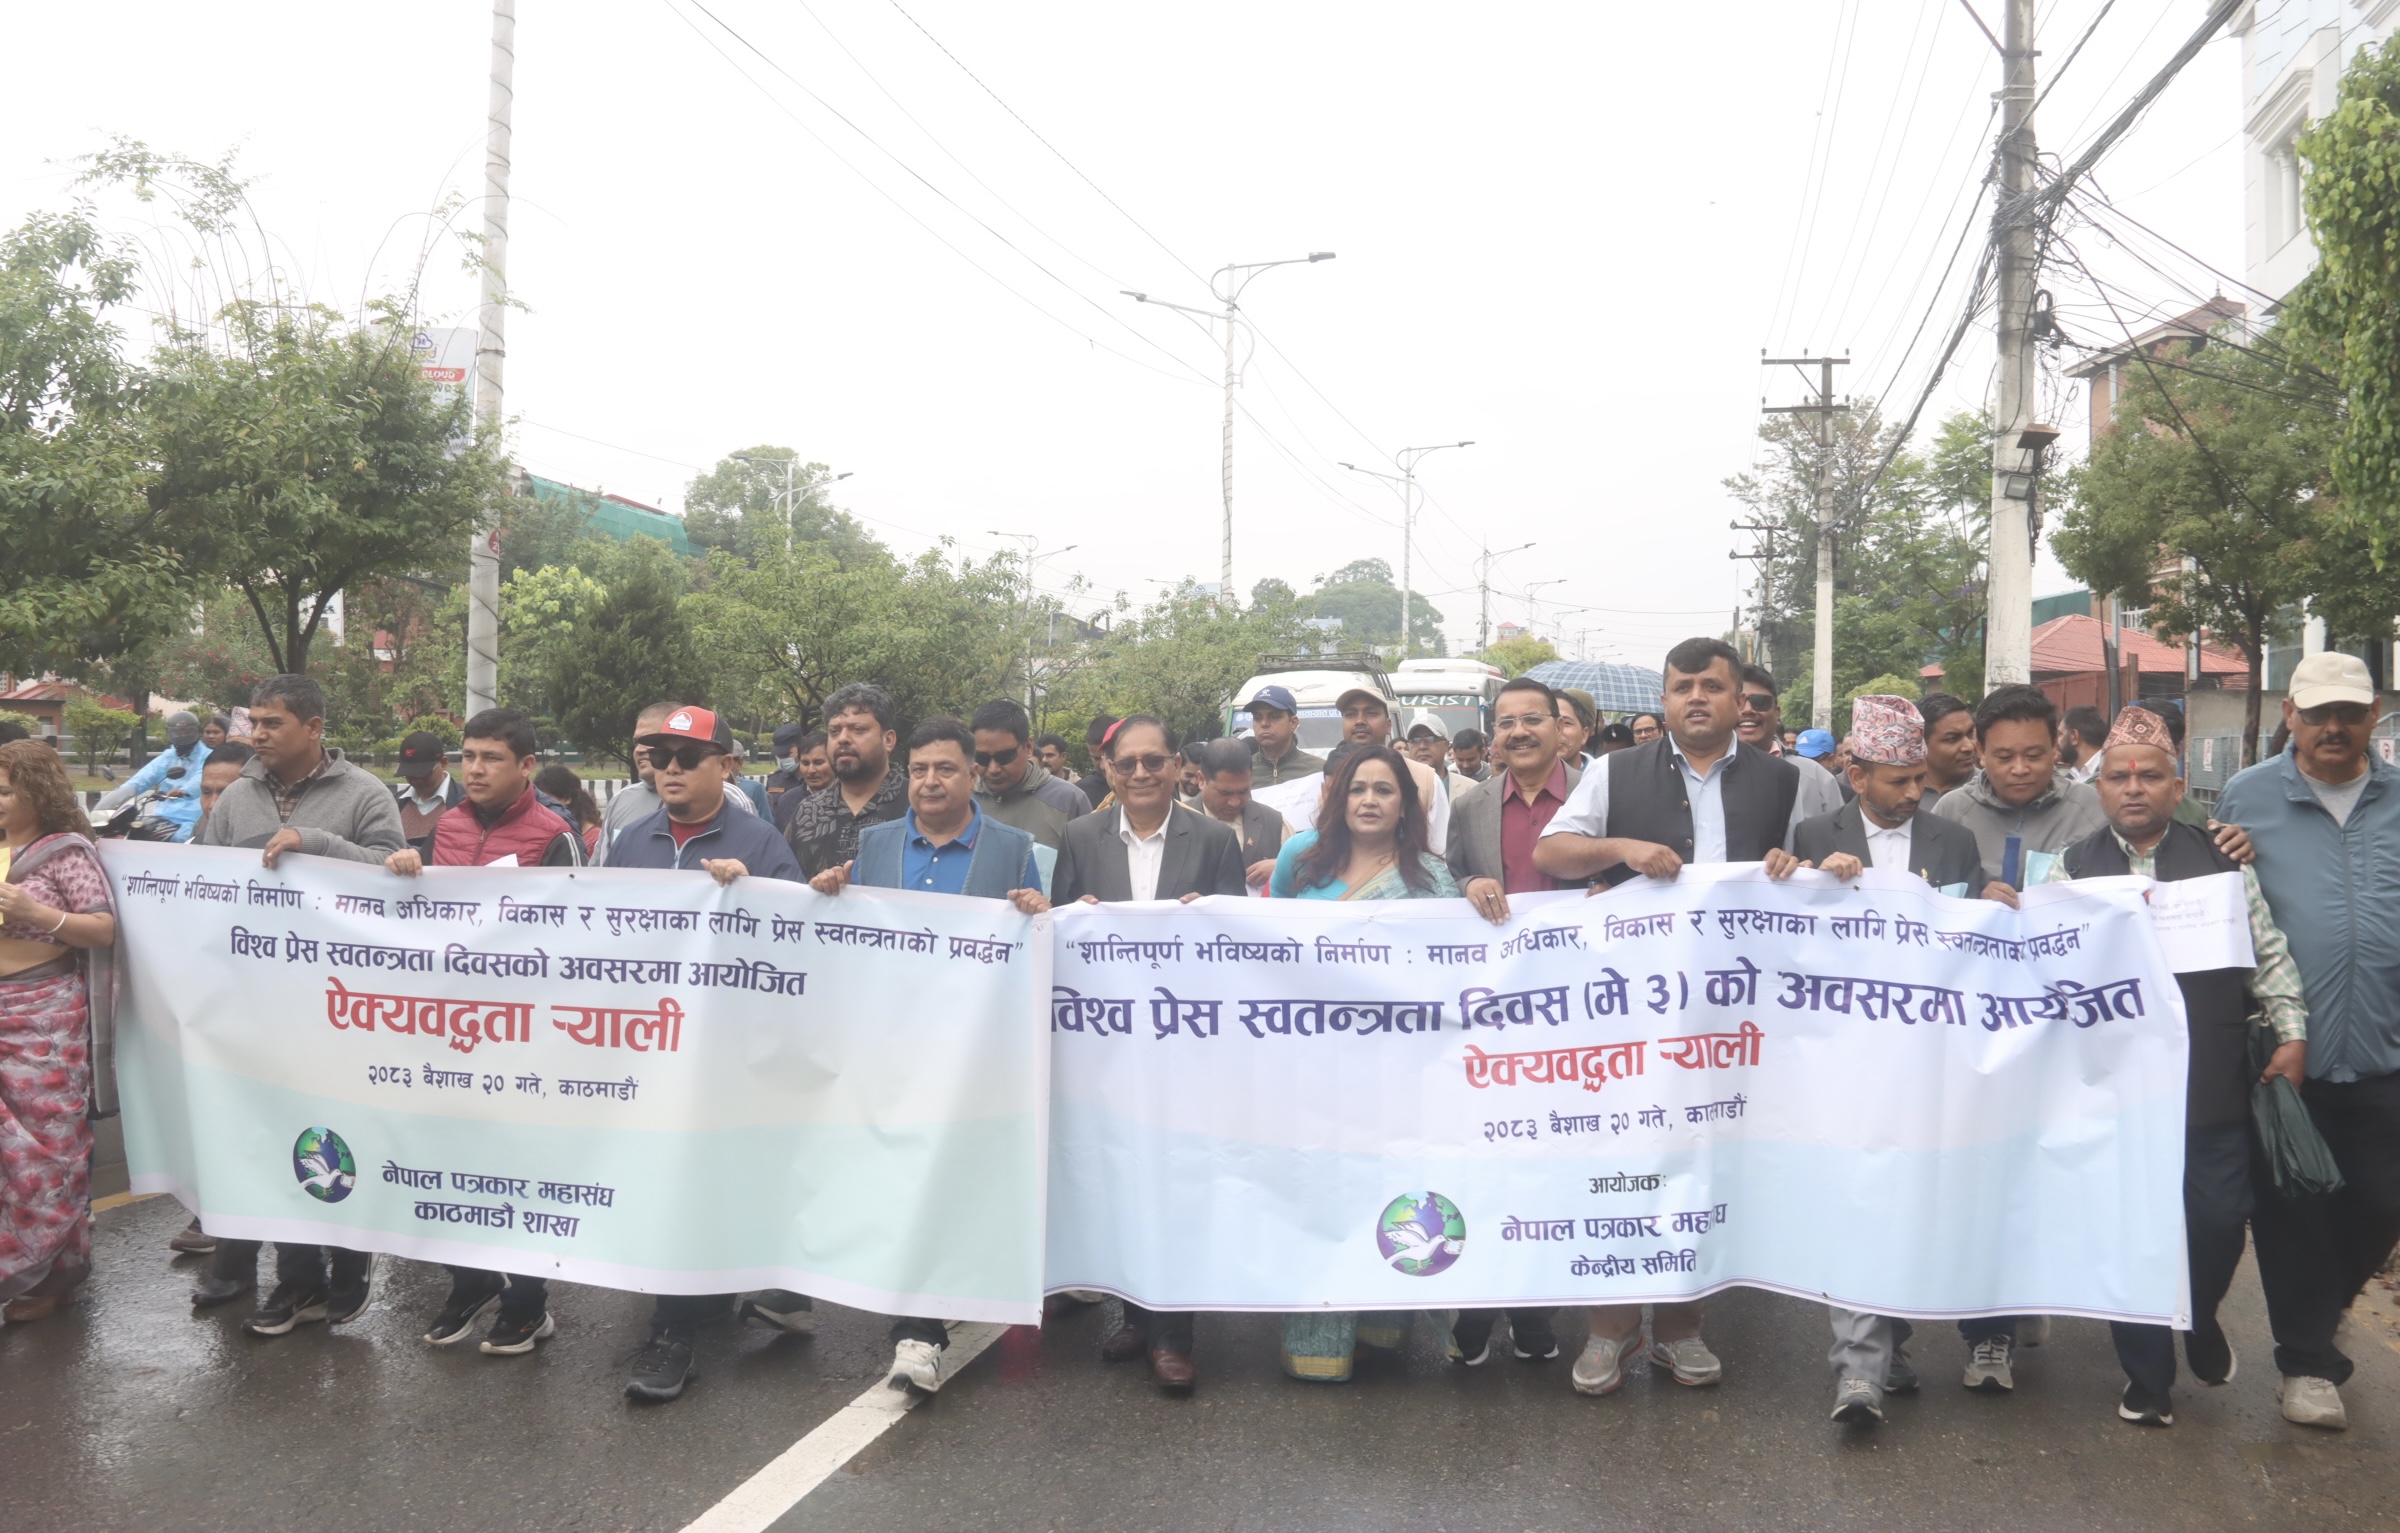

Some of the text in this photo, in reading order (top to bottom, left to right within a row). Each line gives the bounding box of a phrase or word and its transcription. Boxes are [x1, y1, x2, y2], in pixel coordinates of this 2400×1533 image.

[1401, 695, 1475, 706] URIST
[185, 874, 240, 904] भविष्यको
[247, 879, 304, 909] निर्माण
[335, 894, 385, 917] मानव
[396, 894, 483, 927] अधिकार,
[498, 895, 567, 928] विकास
[578, 906, 595, 931] र
[606, 907, 700, 936] सुरक्षाका
[709, 907, 760, 937] लागि
[772, 914, 804, 943] प्रेस
[815, 921, 938, 954] स्वतन्त्रताको
[1195, 933, 1303, 964] भविष्यको
[1314, 935, 1392, 965] निर्माण
[1426, 943, 1488, 965] मानव
[1500, 925, 1588, 960] अधिकार,
[1604, 912, 1675, 943] विकास
[1687, 910, 1706, 936] र
[1717, 909, 1819, 940] सुरक्षाका
[1830, 909, 1887, 940] लागि
[1894, 913, 1929, 947] प्रेस
[231, 925, 807, 997] विश्व प्रेस स्वतन्त्रता दिवसको अवसरमा आयोजित
[1051, 986, 1135, 1037] विश्व
[1150, 986, 1223, 1041] प्रेस
[1239, 999, 1444, 1039] स्वतन्त्रता
[1459, 986, 1570, 1031] दिवस
[1705, 956, 1762, 1007] को
[1776, 971, 1967, 1026] अवसरमा
[368, 1064, 412, 1088] २०८३
[423, 1062, 474, 1089] बैशाख
[482, 1073, 504, 1095] २०
[515, 1072, 546, 1098] गते,
[1484, 1118, 1538, 1142] २०८३
[1549, 1110, 1600, 1136] बैशाख
[1610, 1112, 1629, 1135] २०
[1638, 1104, 1673, 1131] गते,
[381, 1160, 615, 1208] नेपाल पत्रकार महासंघ
[523, 1211, 580, 1238] शाखा
[1500, 1215, 1575, 1242] नेपाल
[1584, 1215, 1662, 1240] पत्रकार
[1570, 1248, 1696, 1278] केन्द्रीय समिति
